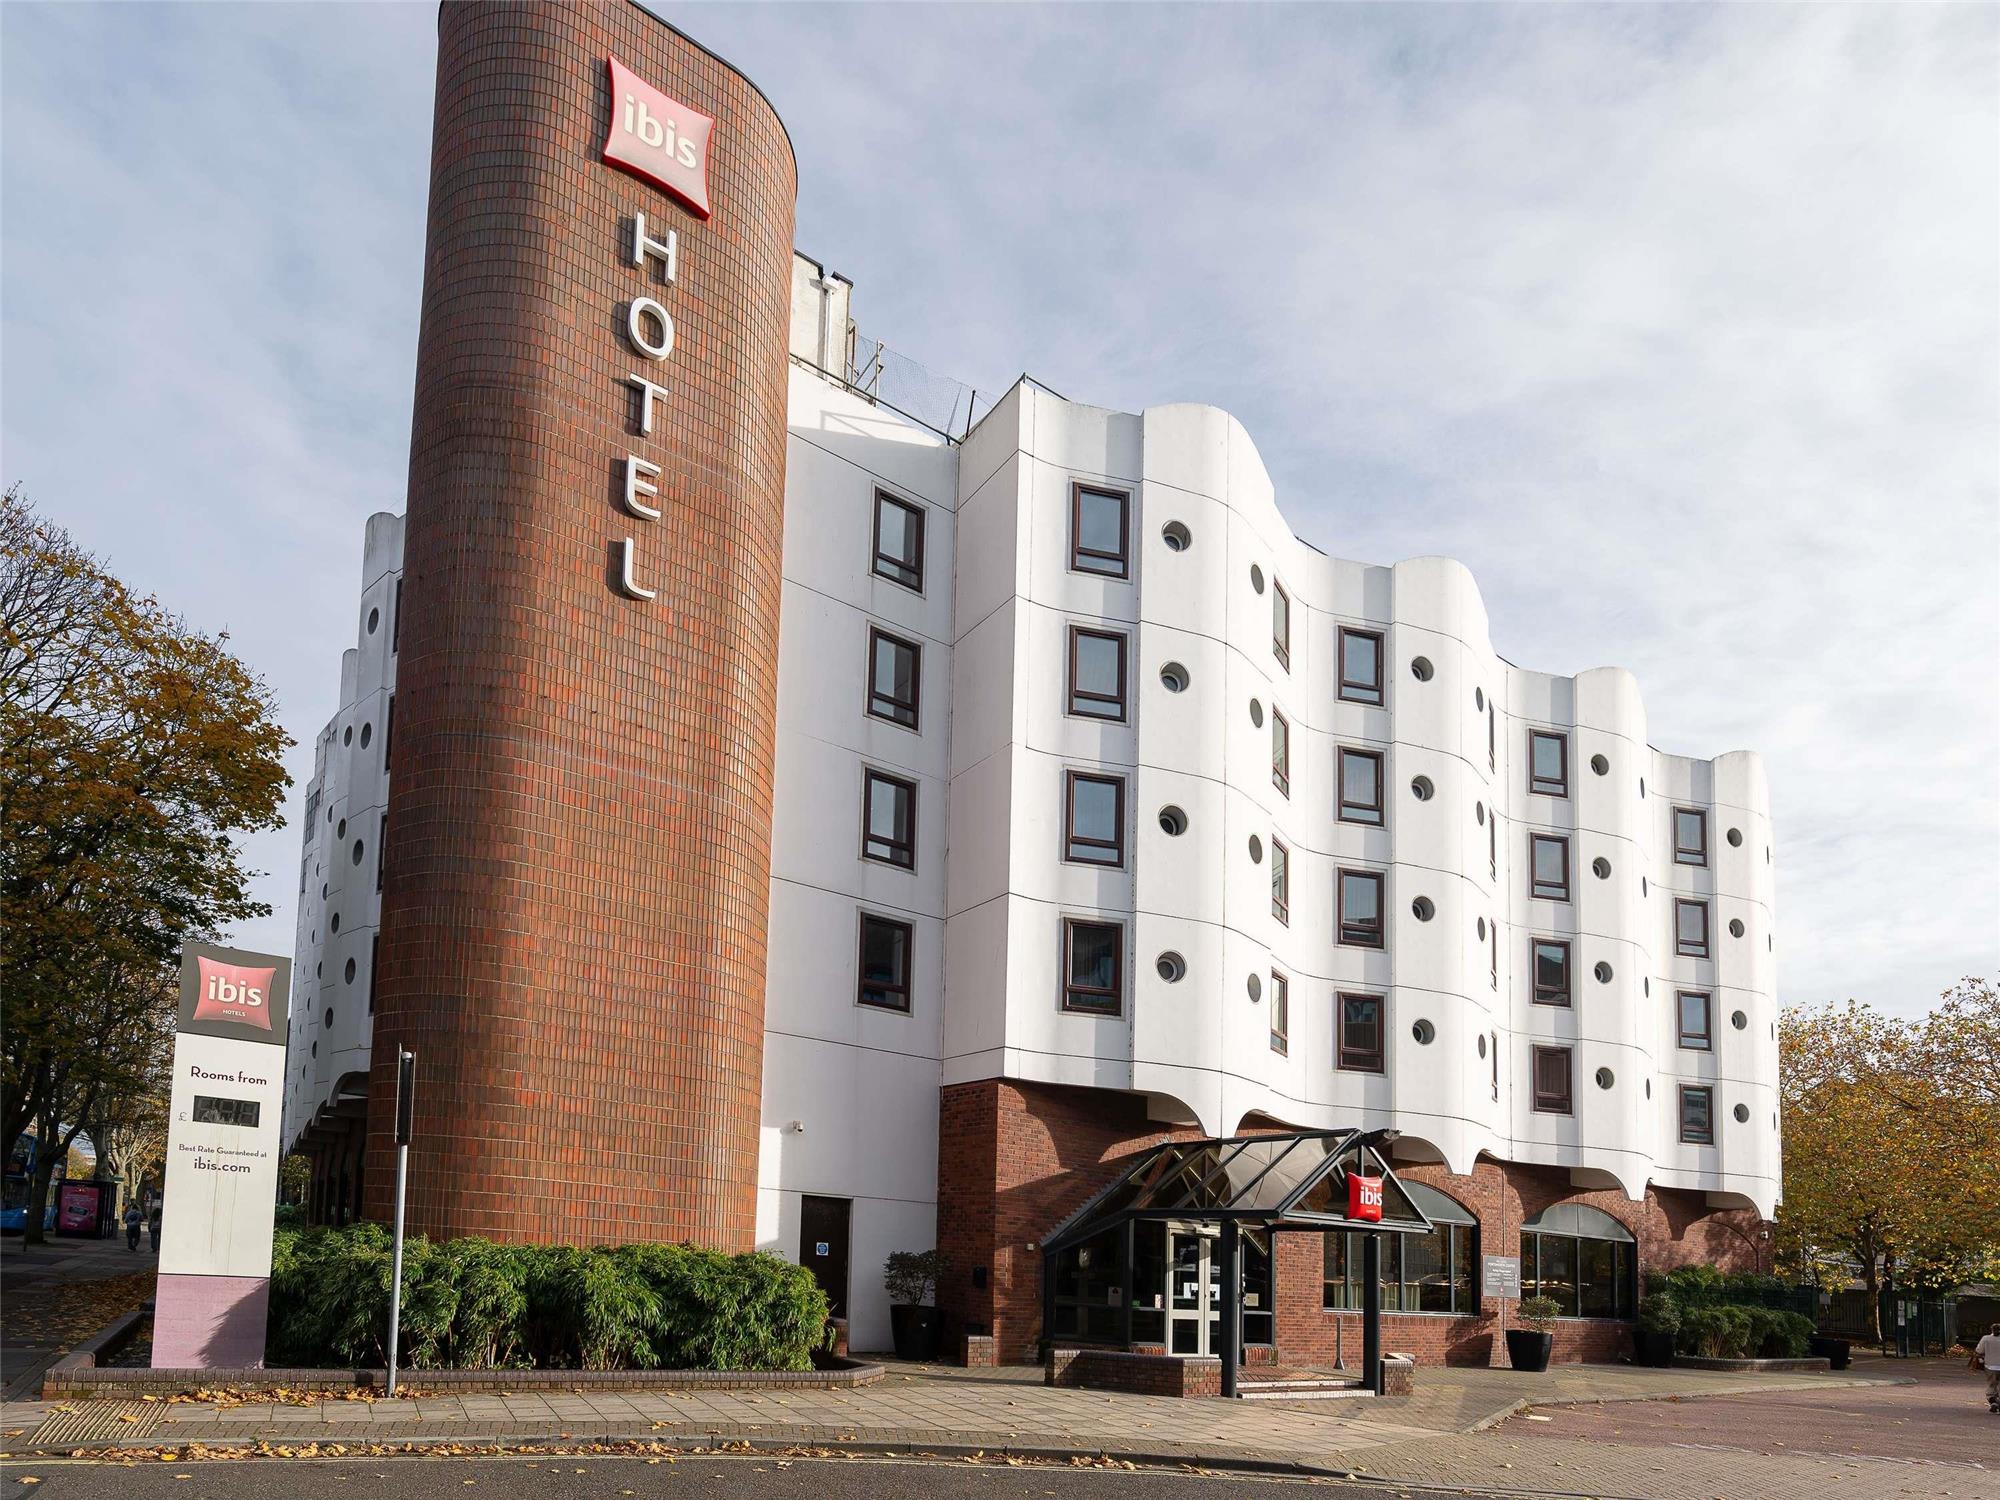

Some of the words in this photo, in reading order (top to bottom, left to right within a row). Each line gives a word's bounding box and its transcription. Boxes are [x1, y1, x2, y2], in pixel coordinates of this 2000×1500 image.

[624, 93, 697, 169] ibis
[621, 211, 677, 602] HOTEL
[207, 975, 263, 1007] ibis
[222, 1008, 246, 1018] HOTELS
[191, 1066, 234, 1082] Rooms
[238, 1071, 267, 1085] from
[178, 1143, 196, 1153] Best
[197, 1145, 215, 1154] Rate
[216, 1146, 259, 1158] Guaranteed
[194, 1156, 251, 1173] ibis.com
[1360, 1185, 1383, 1207] ibis
